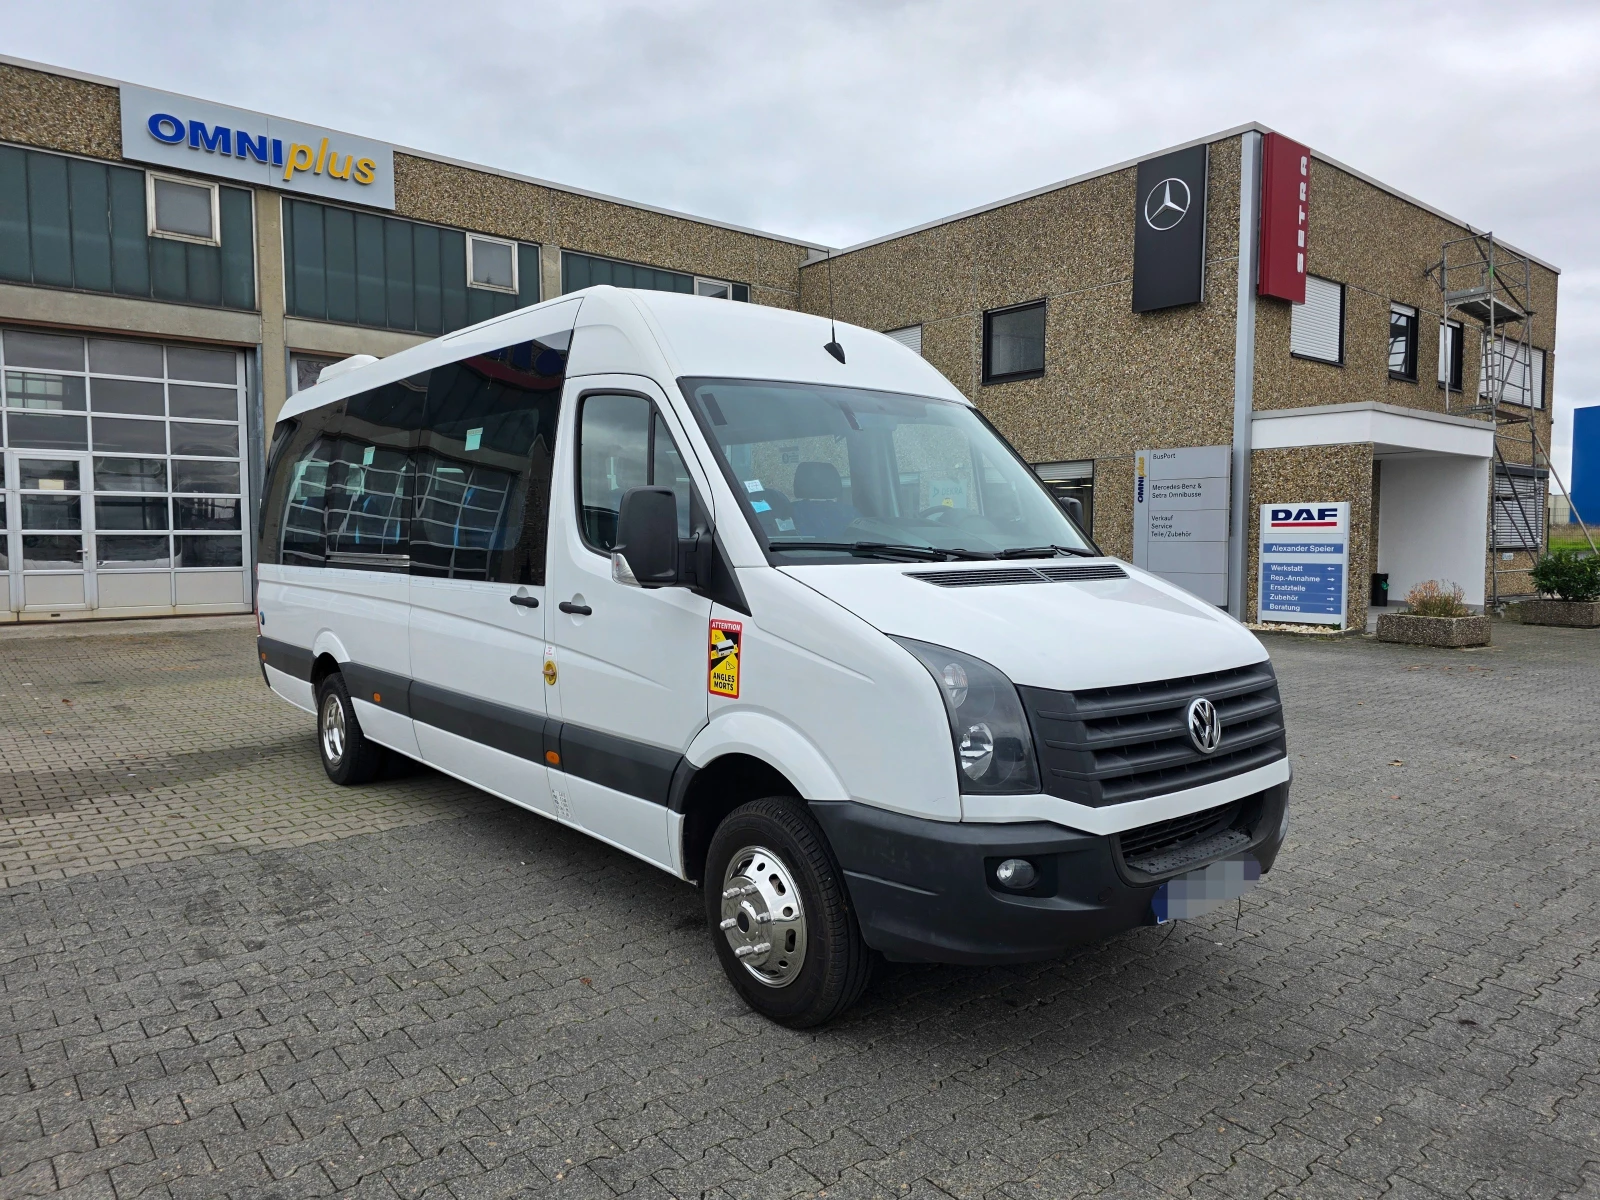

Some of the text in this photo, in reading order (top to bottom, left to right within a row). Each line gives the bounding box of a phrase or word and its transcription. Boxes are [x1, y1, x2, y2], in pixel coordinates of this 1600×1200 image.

[1297, 156, 1308, 274] SETRA
[1271, 508, 1338, 521] DAF
[1309, 545, 1335, 553] Speier
[1270, 564, 1304, 572] Werkstatt
[1270, 574, 1321, 583] Rep.-Annahme
[1270, 584, 1306, 592] Ersatzteile
[1269, 603, 1301, 612] Beratung
[711, 622, 741, 631] ATTENTION
[713, 672, 735, 683] ANGLES
[713, 680, 734, 691] MORTS
